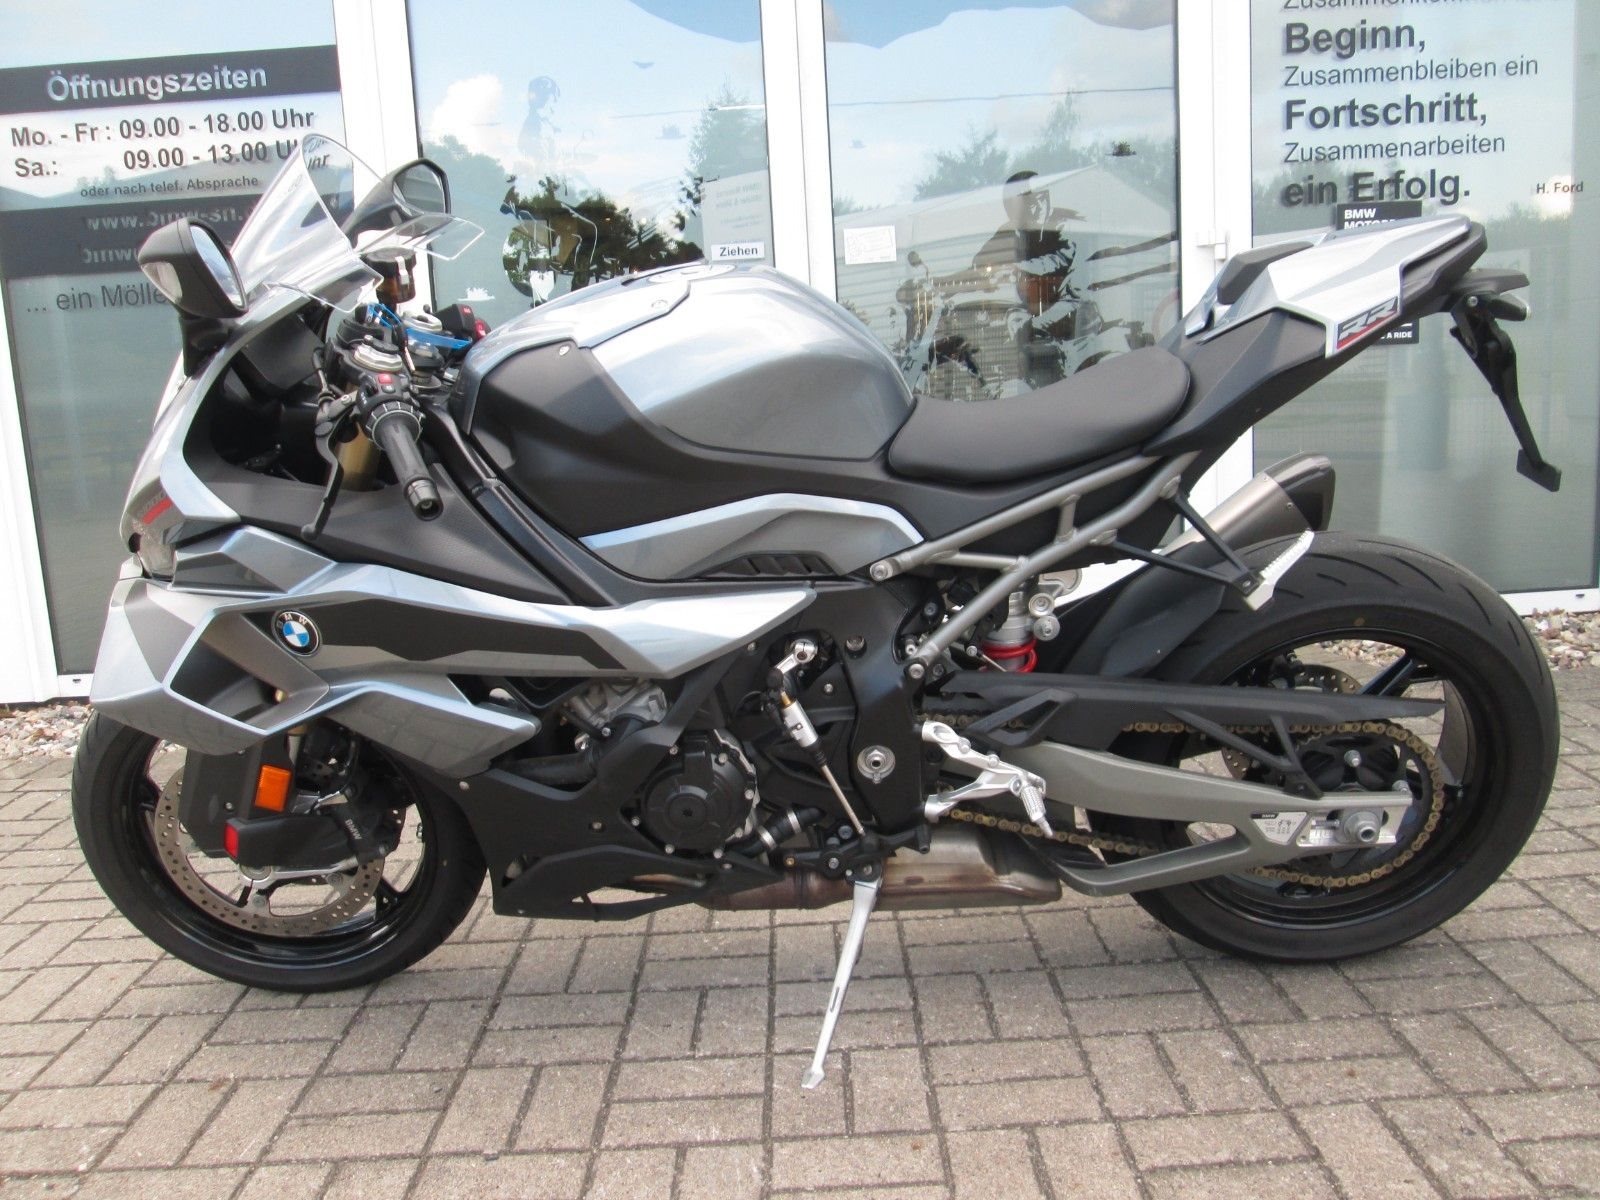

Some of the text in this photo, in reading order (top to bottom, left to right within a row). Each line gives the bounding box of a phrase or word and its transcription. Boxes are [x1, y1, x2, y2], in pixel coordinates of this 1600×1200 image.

[1286, 19, 1426, 59] Beginn,
[47, 66, 267, 101] Öffnungszeiten
[1284, 55, 1539, 87] Zusammenbleiben ein
[1286, 92, 1488, 130] Fortschritt,
[11, 127, 52, 147] Mo.
[119, 117, 180, 139] 09.00
[204, 111, 264, 134] 18.00
[272, 108, 314, 128] Uhr
[14, 157, 58, 177] Sa.:
[123, 147, 185, 170] 09.00
[208, 142, 267, 164] 13.00
[1284, 134, 1506, 163] Zusammenarbeiten
[80, 176, 259, 197] oder nach telef. Absprache
[1285, 169, 1471, 207] ein Erfolg.
[1536, 181, 1585, 194] H. Ford
[1344, 208, 1377, 219] BMW
[719, 246, 758, 257] Ziehen
[56, 288, 92, 310] ein
[101, 283, 168, 308] Mölle
[1393, 331, 1413, 339] RIDE
[345, 819, 362, 839] BMW
